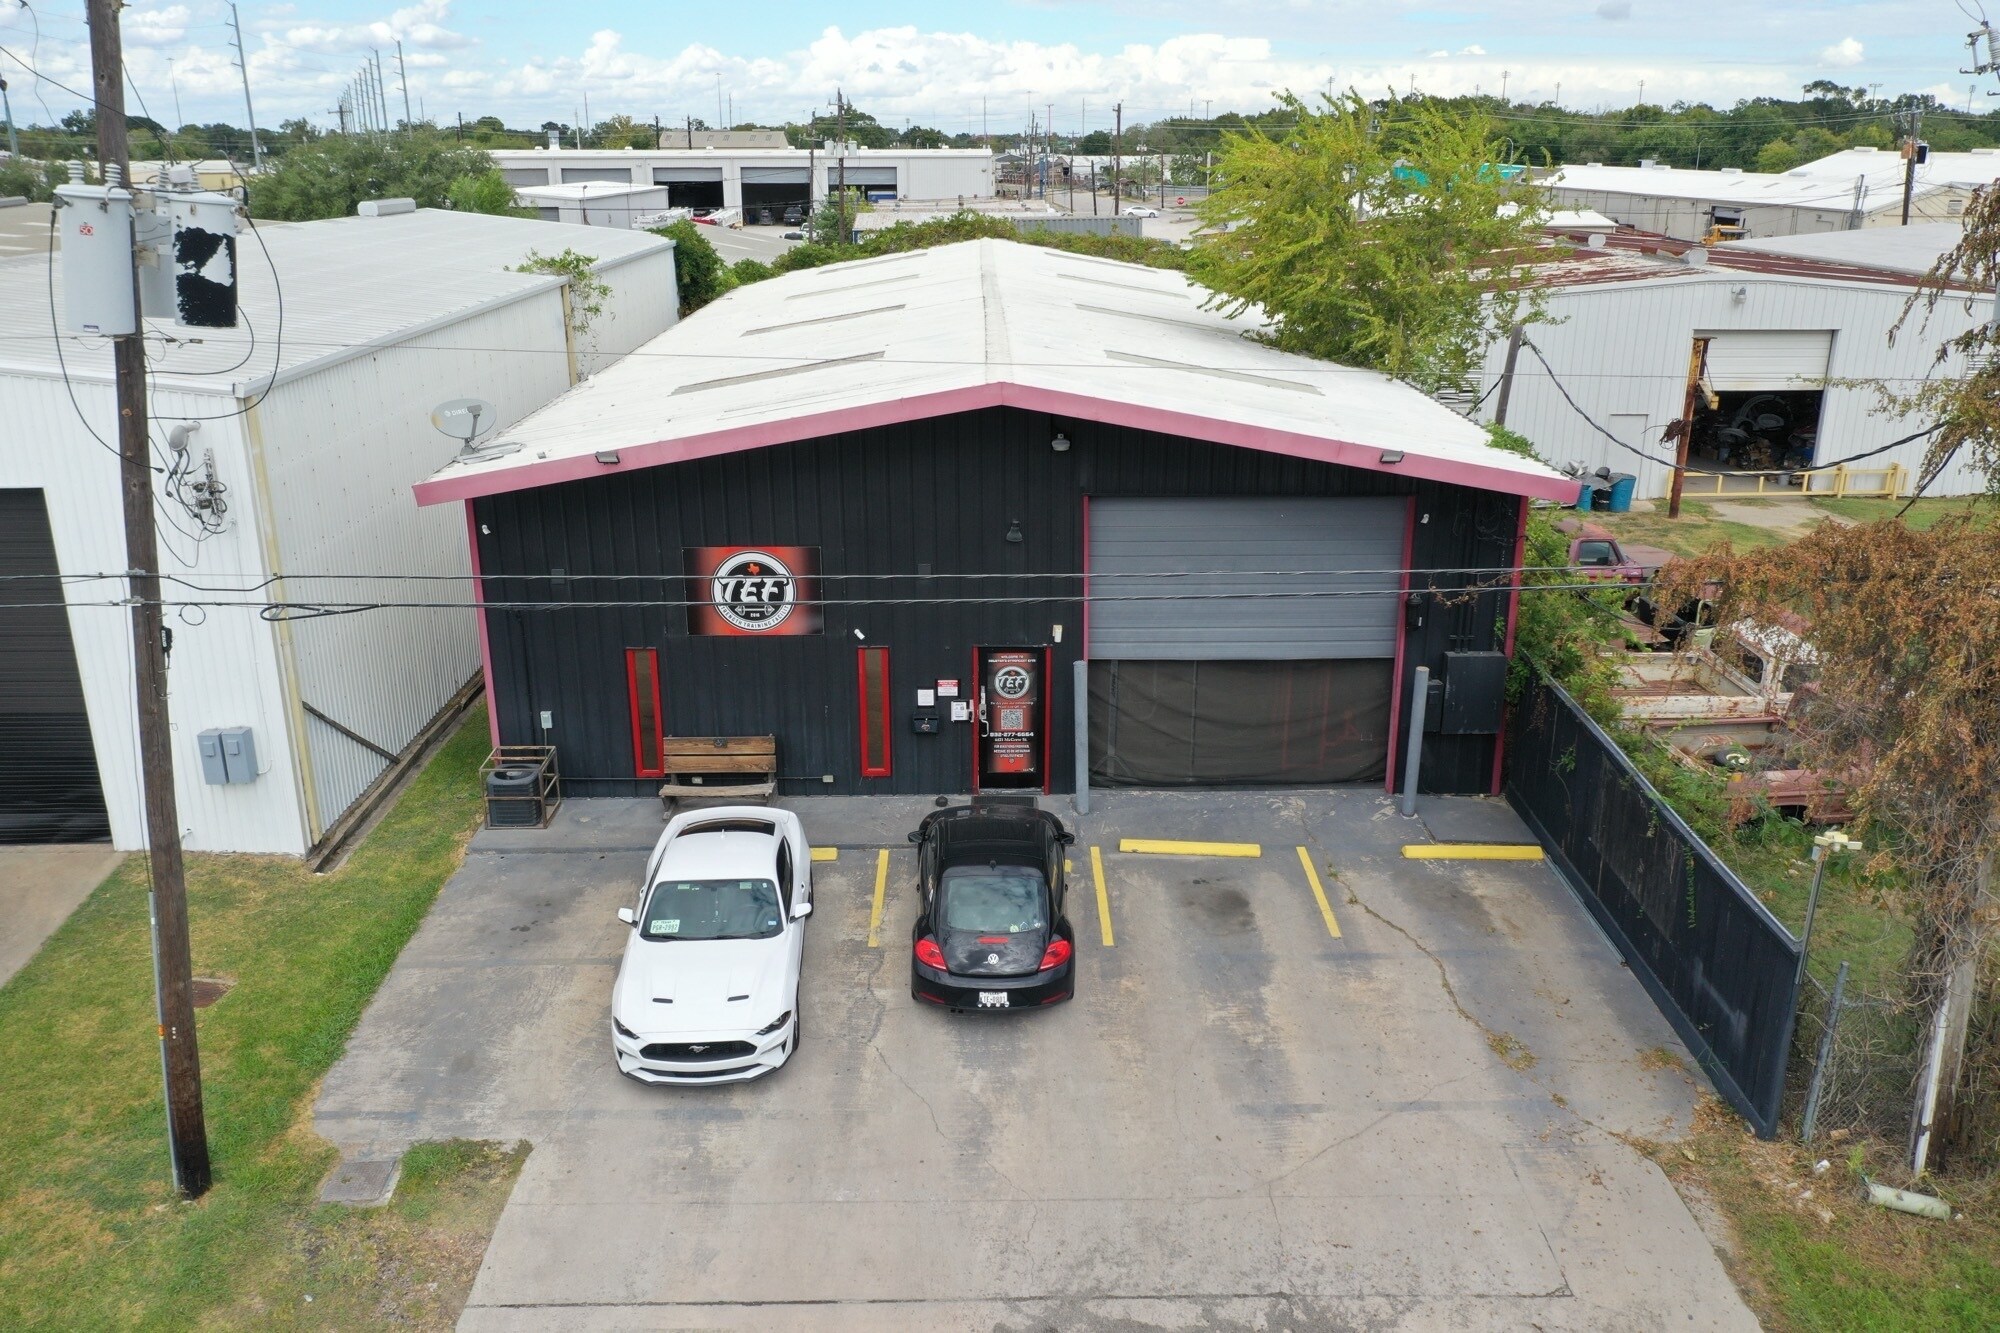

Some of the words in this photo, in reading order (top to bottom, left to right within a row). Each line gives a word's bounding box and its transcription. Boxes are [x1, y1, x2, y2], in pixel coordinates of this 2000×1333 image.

[719, 574, 788, 602] TEF
[743, 620, 772, 629] TRAINING
[998, 675, 1027, 688] TEF
